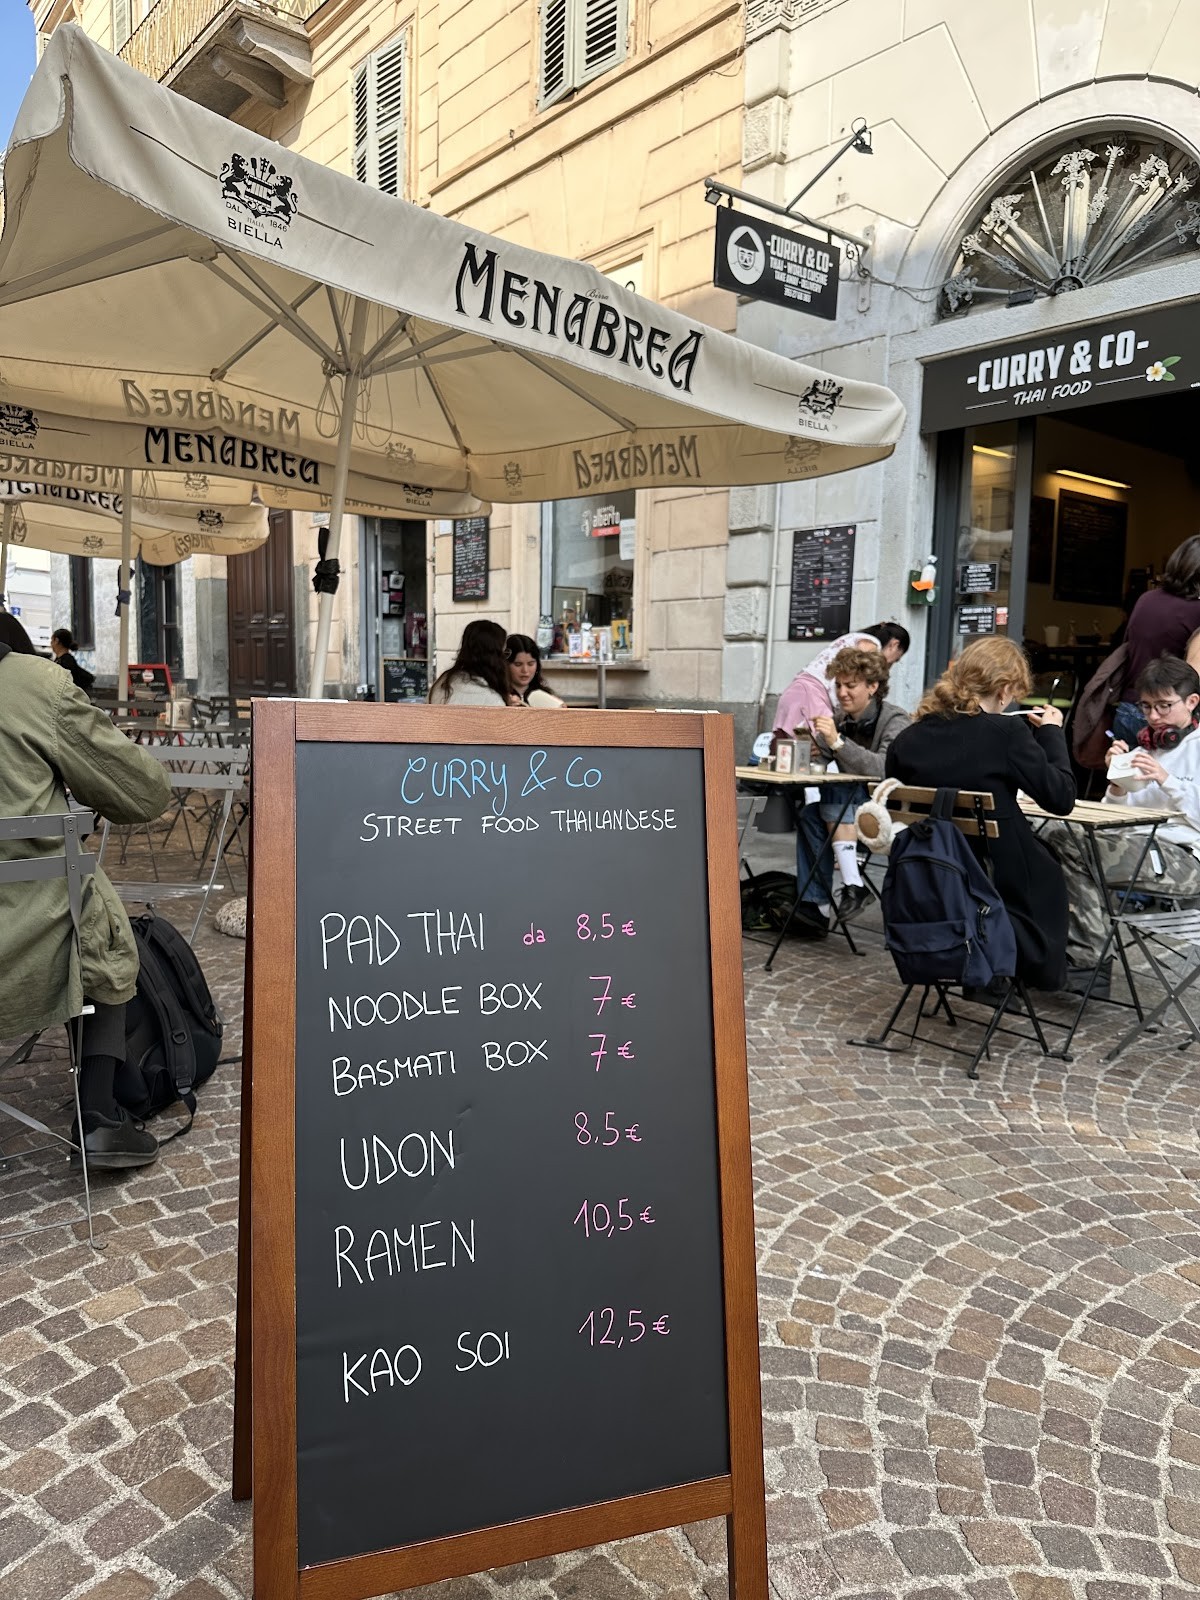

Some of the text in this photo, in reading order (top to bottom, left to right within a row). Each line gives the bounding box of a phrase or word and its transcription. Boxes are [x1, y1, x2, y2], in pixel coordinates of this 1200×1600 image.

[225, 201, 243, 214] DAL
[270, 219, 288, 233] 1846
[227, 216, 283, 250] BIELLA
[806, 247, 816, 269] &
[455, 242, 706, 395] MENABREA
[1070, 339, 1093, 376] &
[1013, 380, 1093, 405] THAI FOOD
[798, 418, 830, 432] BIELLA
[400, 756, 508, 816] CURRY
[520, 750, 557, 796] &
[359, 809, 678, 842] STREET FOOD THAILANDESE
[320, 912, 401, 970] PAD
[407, 909, 485, 956] THAI
[522, 923, 546, 946] da
[328, 986, 463, 1033] NOODLE
[479, 982, 543, 1016] BOX
[332, 1050, 457, 1097] BASMATI
[482, 1039, 549, 1073] BOX
[339, 1129, 456, 1191] UDON
[334, 1218, 477, 1289] RAMEN
[342, 1344, 423, 1404] KAO
[455, 1331, 511, 1372] SOI
